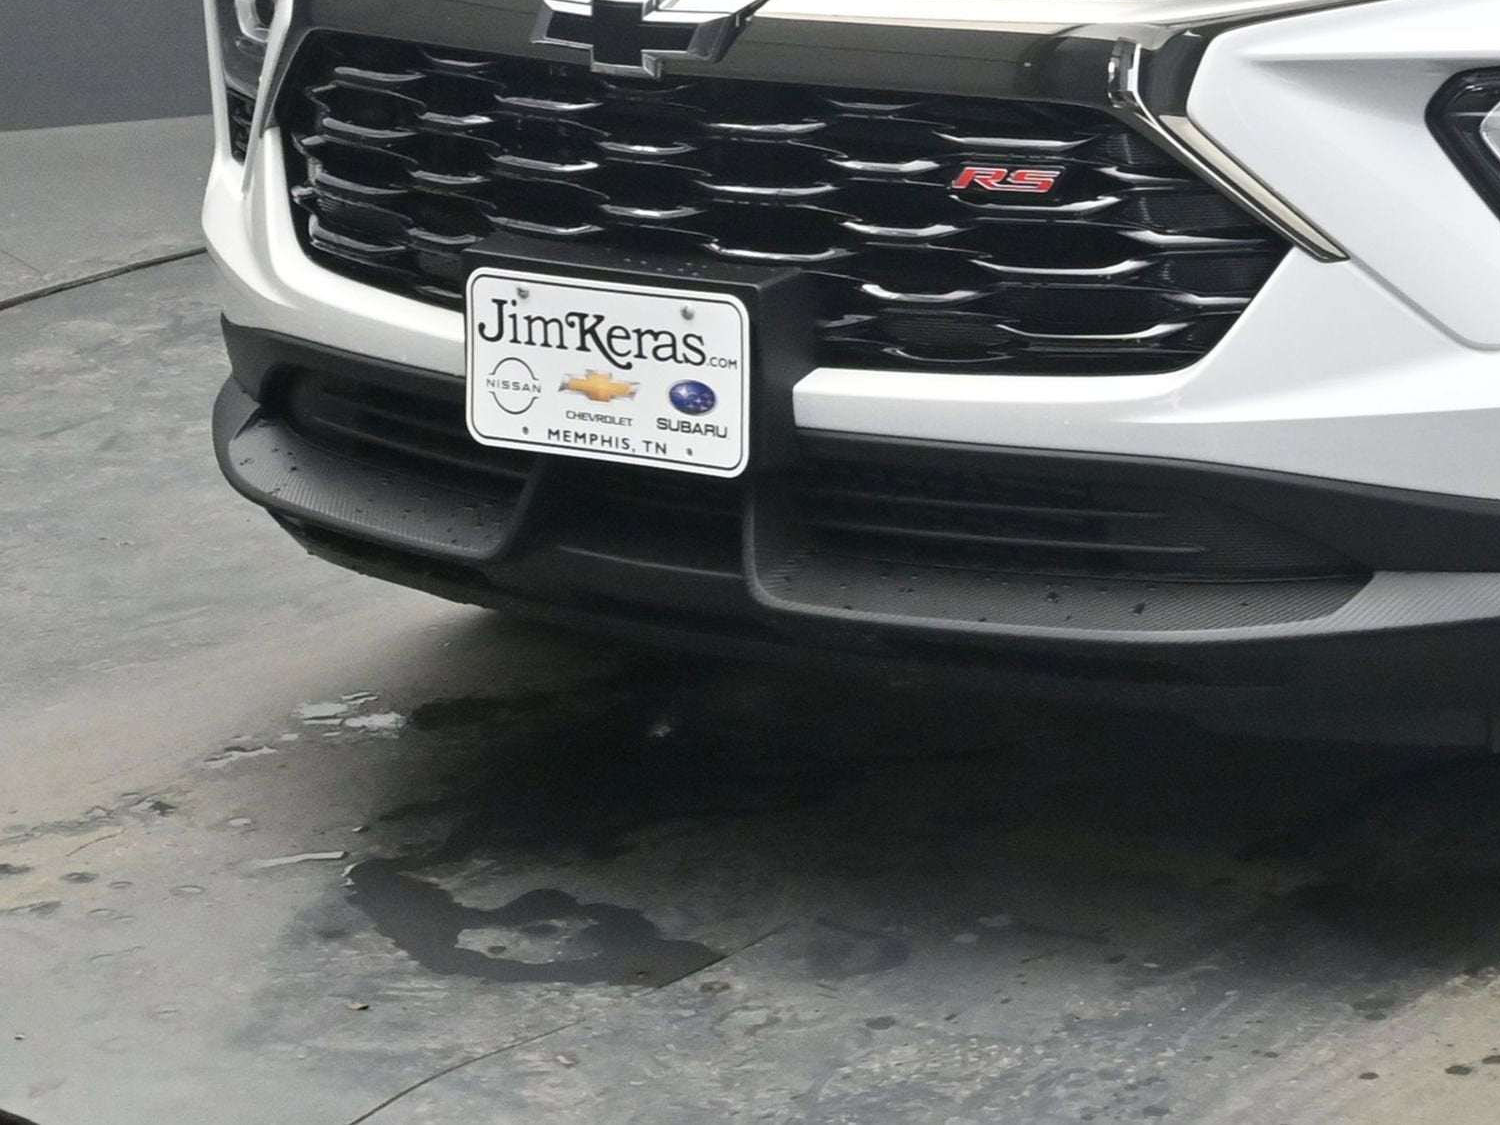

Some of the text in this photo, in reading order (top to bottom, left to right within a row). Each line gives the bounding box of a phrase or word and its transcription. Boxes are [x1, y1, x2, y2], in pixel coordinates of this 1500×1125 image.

[951, 166, 1062, 193] RS
[486, 378, 542, 394] NISSAN
[565, 410, 633, 427] CHEVROLET
[656, 417, 729, 439] SUBARU
[547, 428, 668, 455] MEMPHIS, TN
